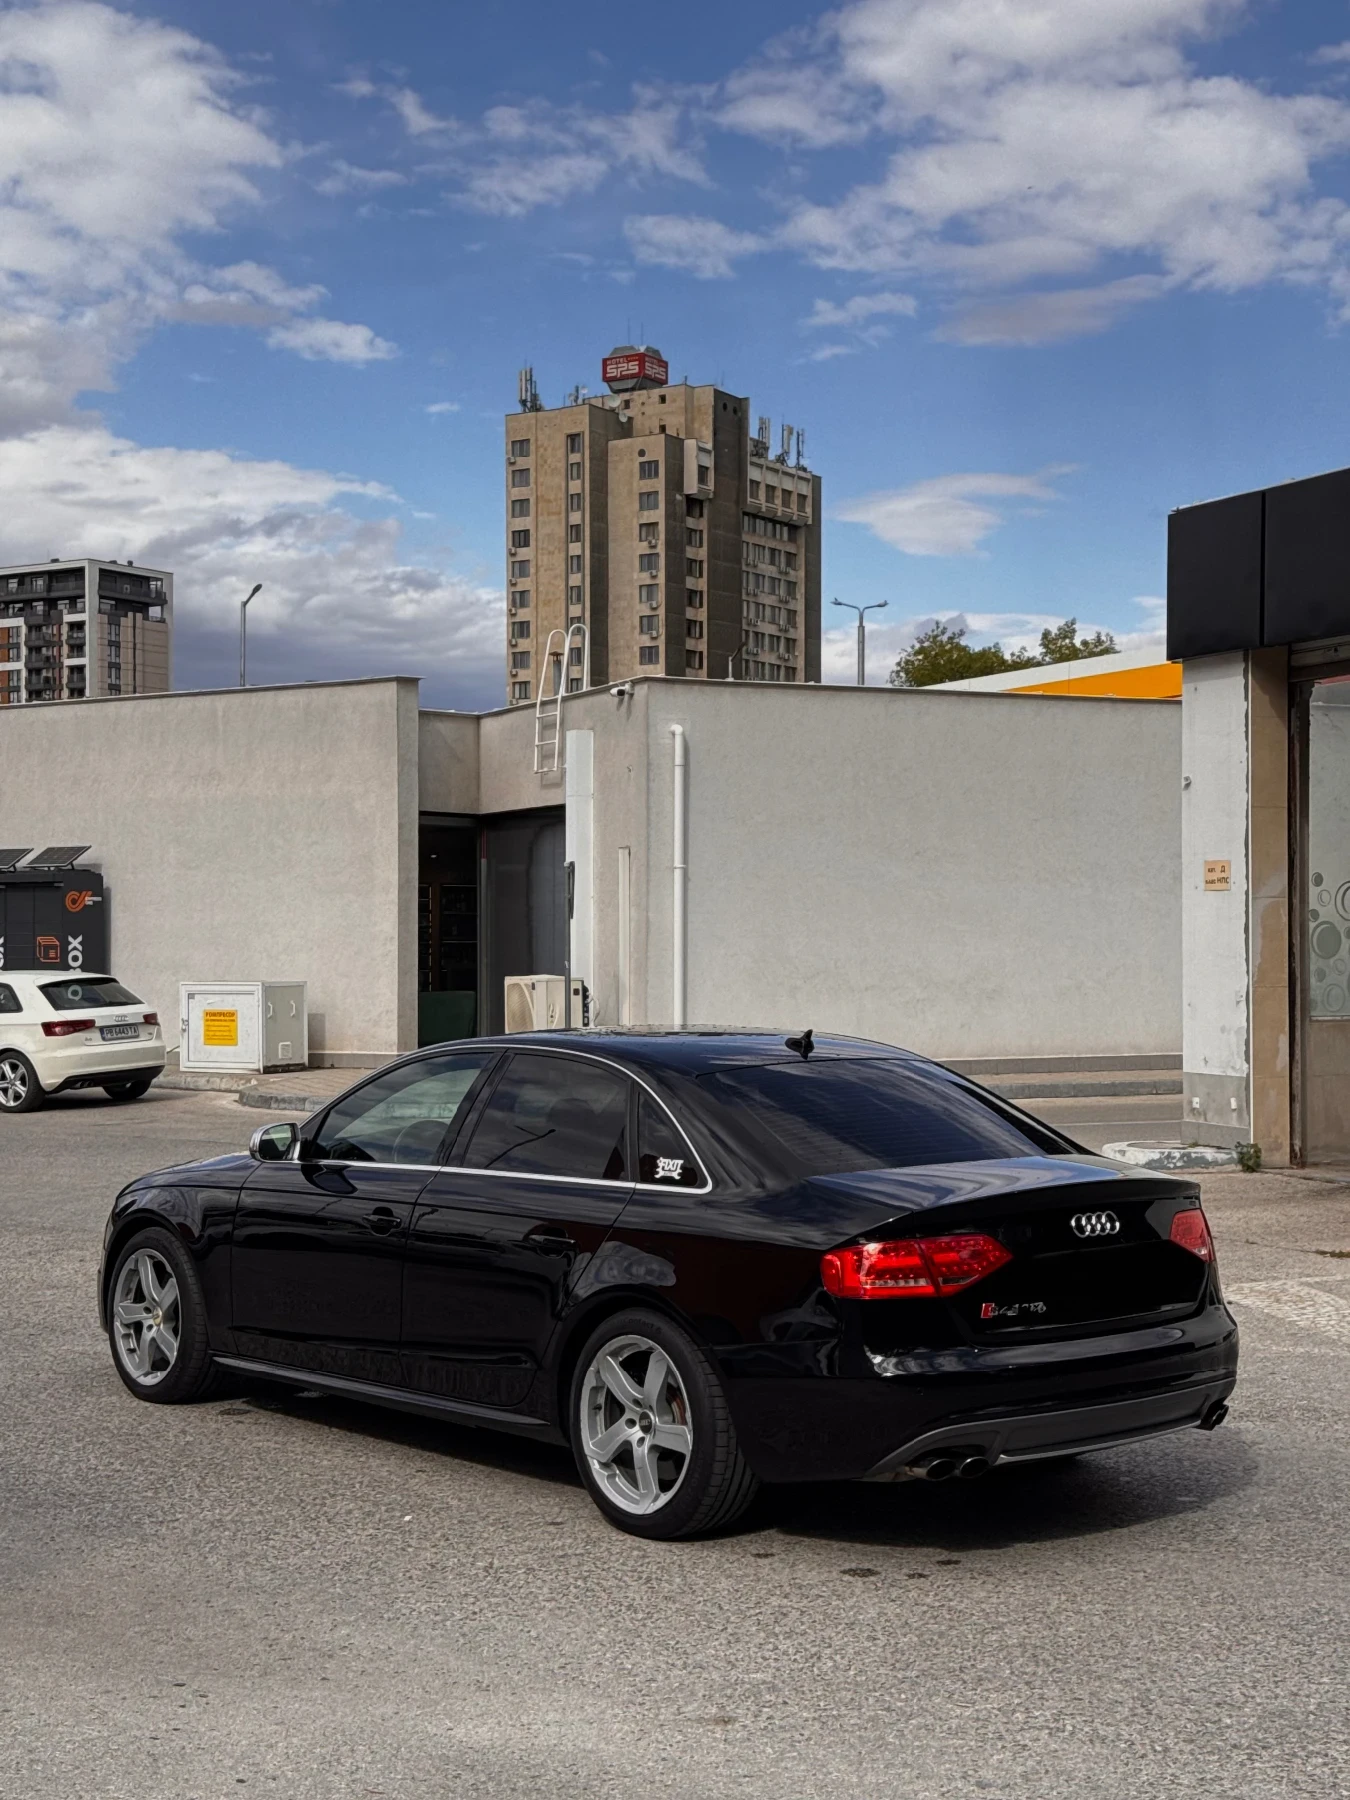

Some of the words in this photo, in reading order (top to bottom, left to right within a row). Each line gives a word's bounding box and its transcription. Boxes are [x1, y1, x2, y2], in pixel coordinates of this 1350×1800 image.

[606, 357, 628, 365] HOTEL
[606, 361, 639, 378] SPS
[645, 362, 666, 380] SPS
[1220, 864, 1226, 873] Д
[1217, 876, 1230, 884] НПС
